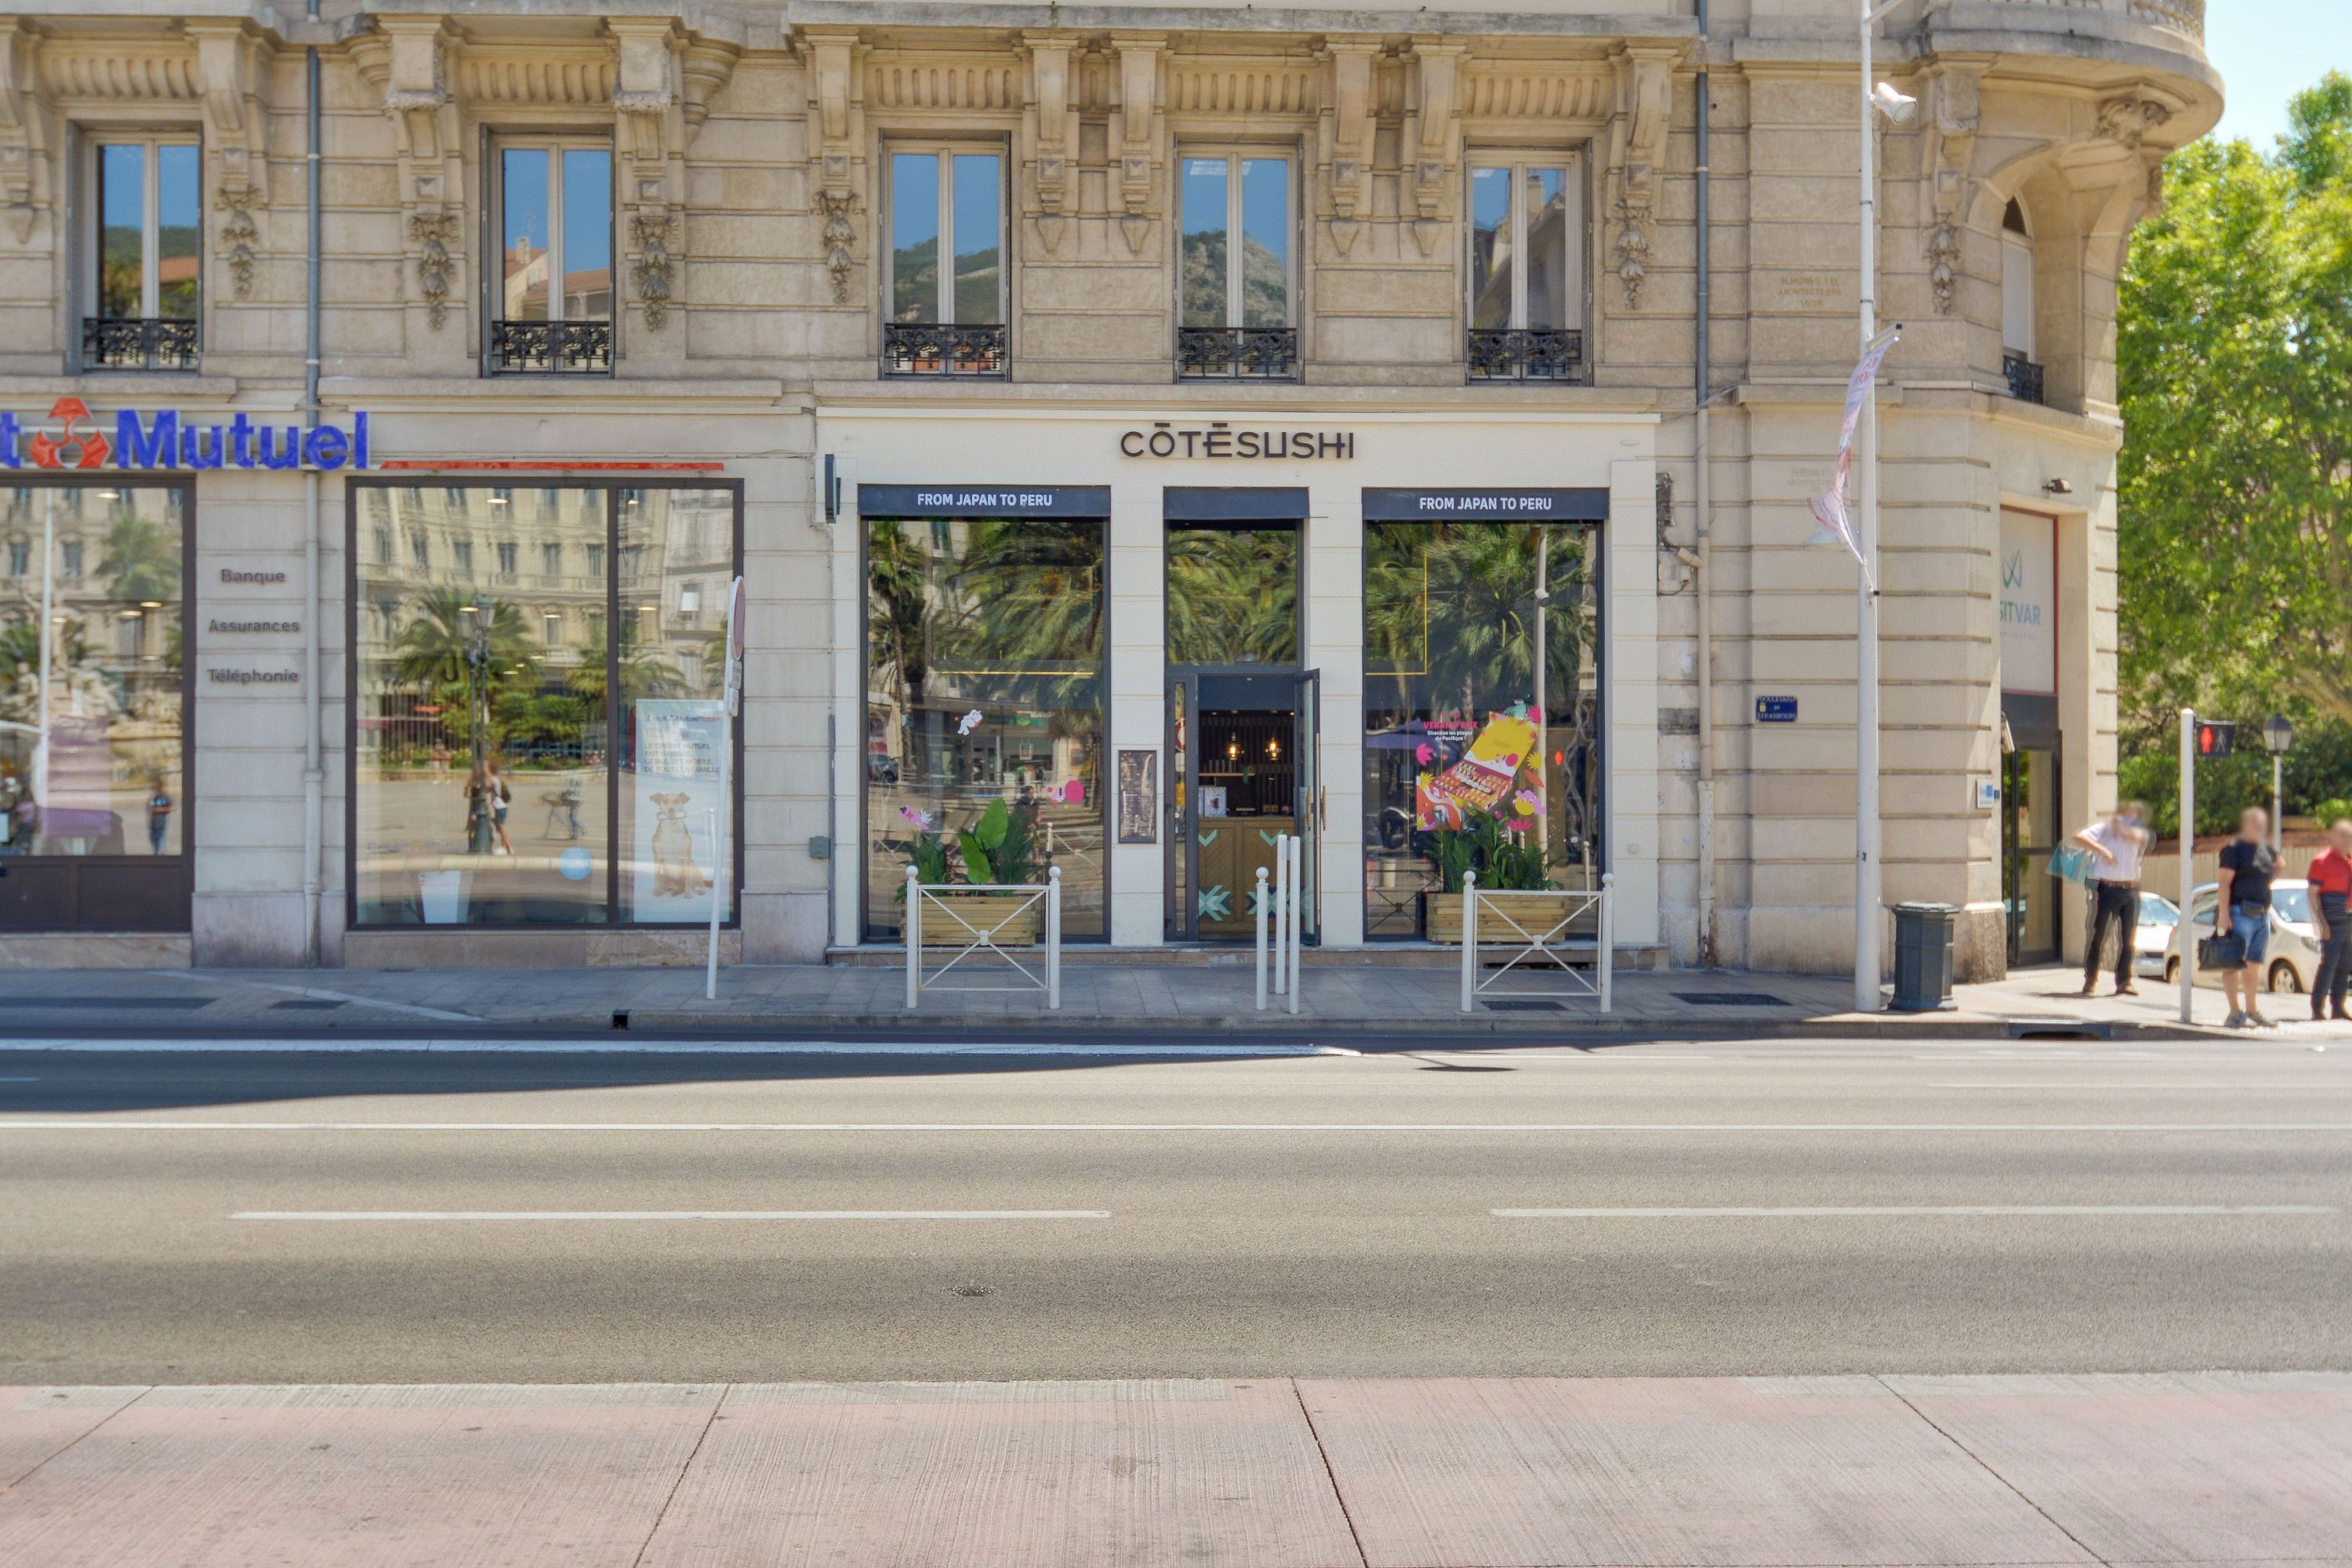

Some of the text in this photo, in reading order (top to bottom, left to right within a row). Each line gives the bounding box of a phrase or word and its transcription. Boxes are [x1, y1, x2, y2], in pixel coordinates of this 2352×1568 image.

[117, 410, 369, 470] Mutuel
[918, 493, 1052, 506] FROM JAPAN TO PERU
[1420, 497, 1552, 510] FROM JAPAN TO PERU
[220, 568, 285, 586] Banque
[209, 619, 300, 634] Assurances
[208, 667, 299, 686] Téléphonie
